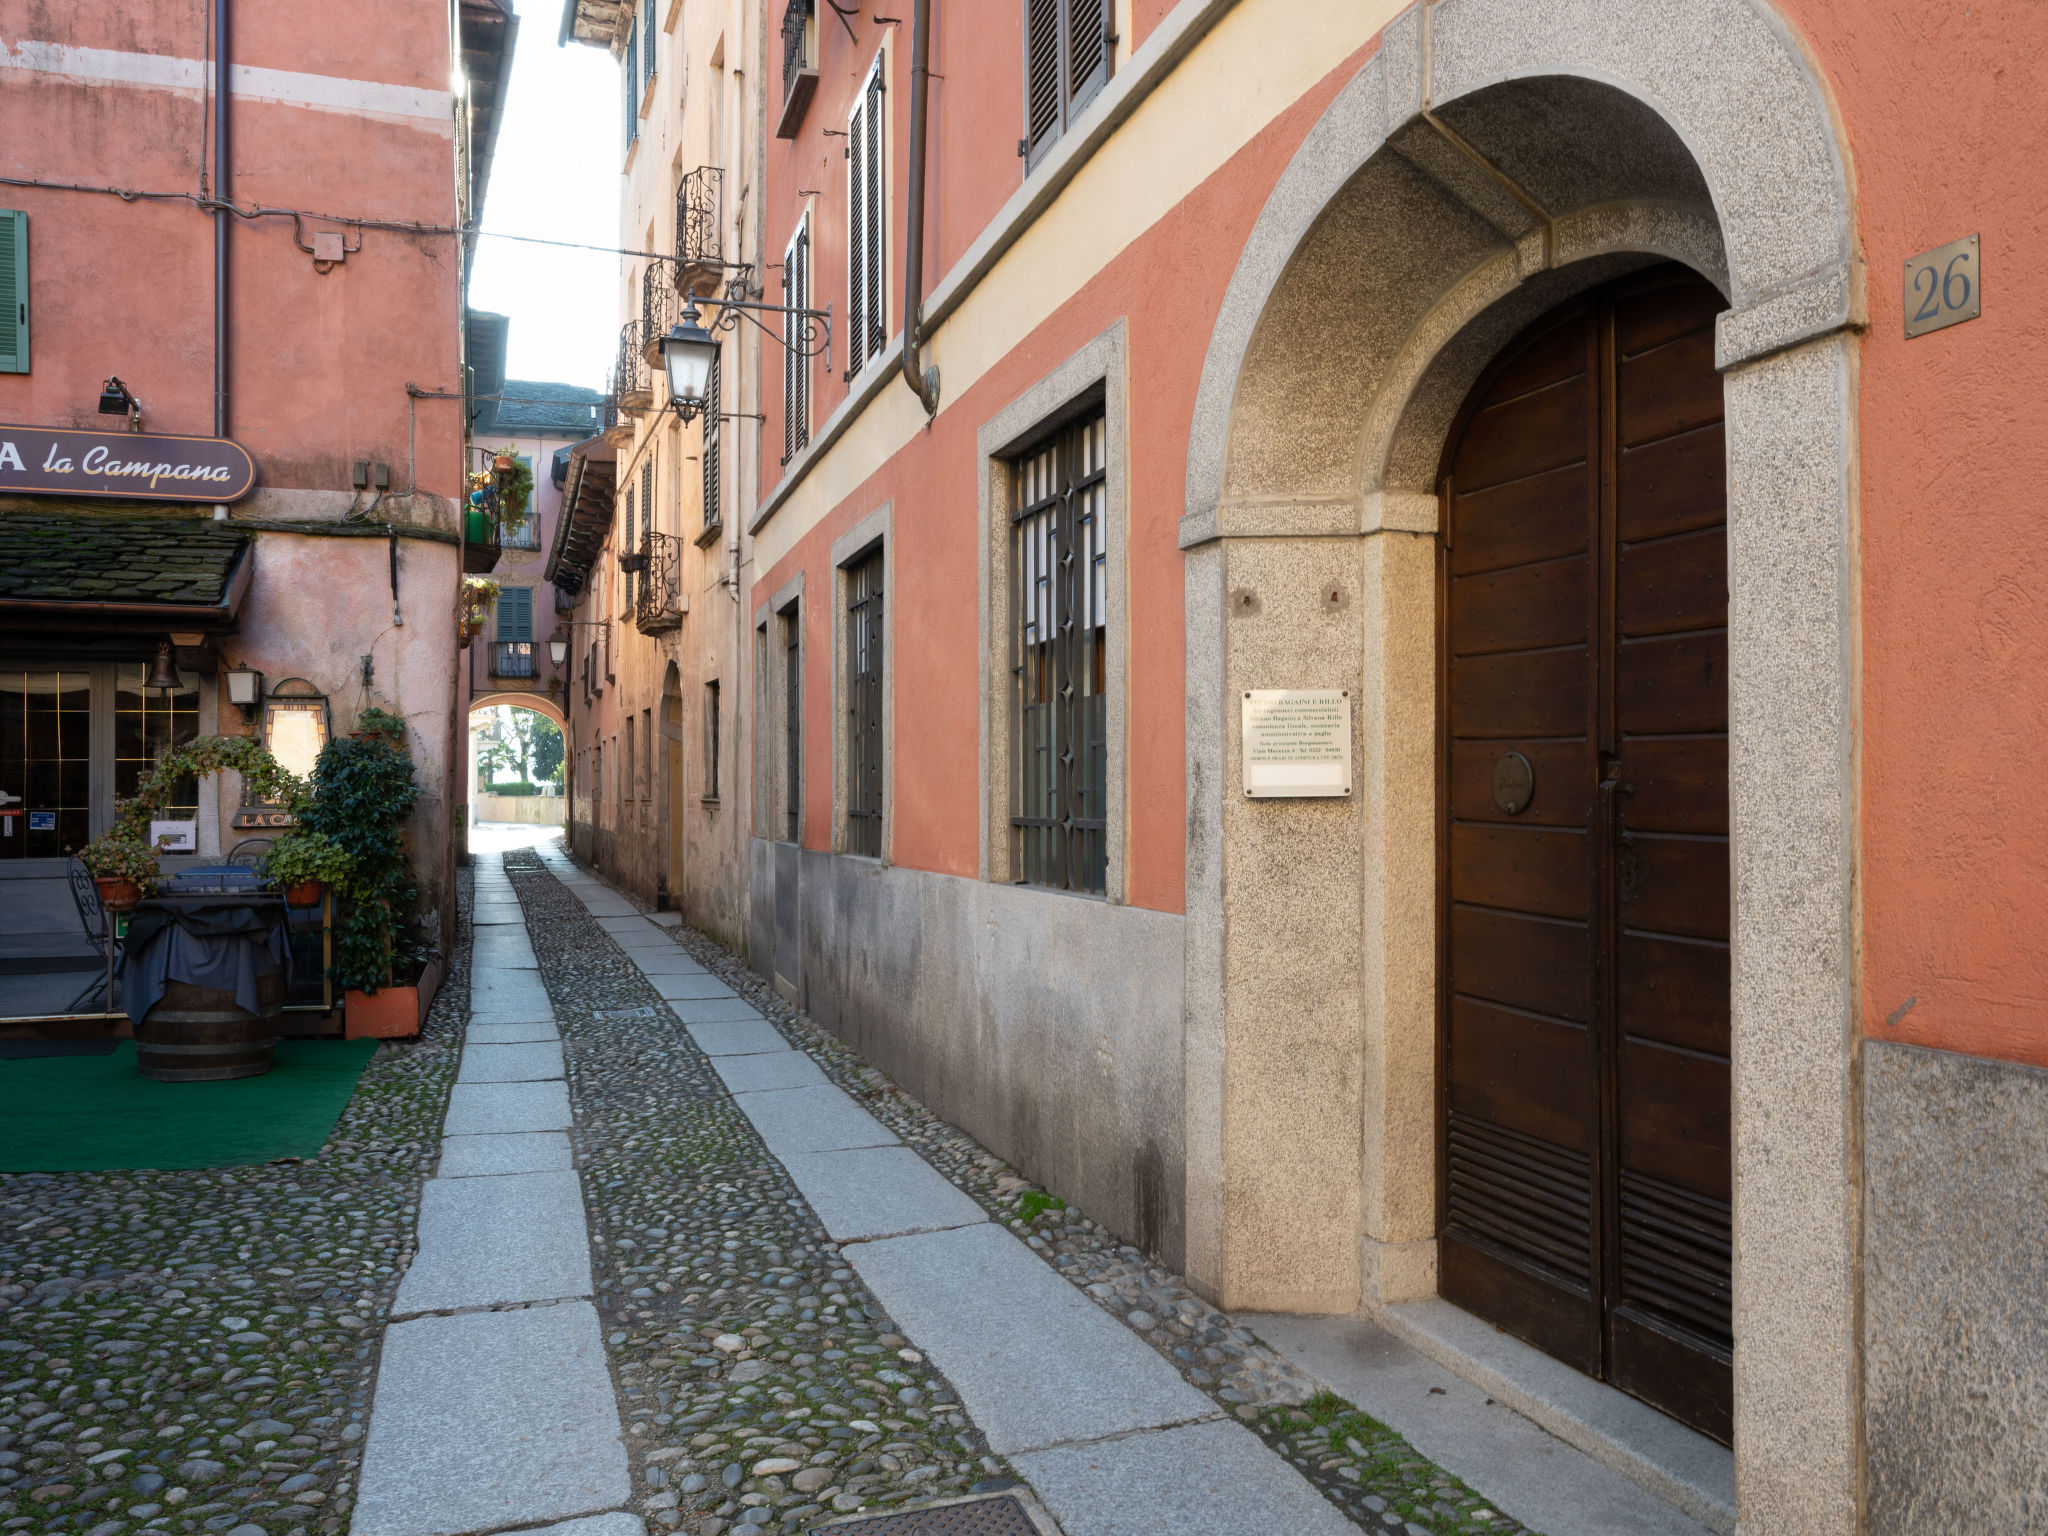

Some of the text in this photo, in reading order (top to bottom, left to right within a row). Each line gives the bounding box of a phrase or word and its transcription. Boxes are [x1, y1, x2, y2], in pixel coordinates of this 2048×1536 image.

[1913, 253, 1971, 322] 26
[43, 443, 74, 473] la
[82, 446, 231, 489] Campana
[242, 813, 266, 827] LA
